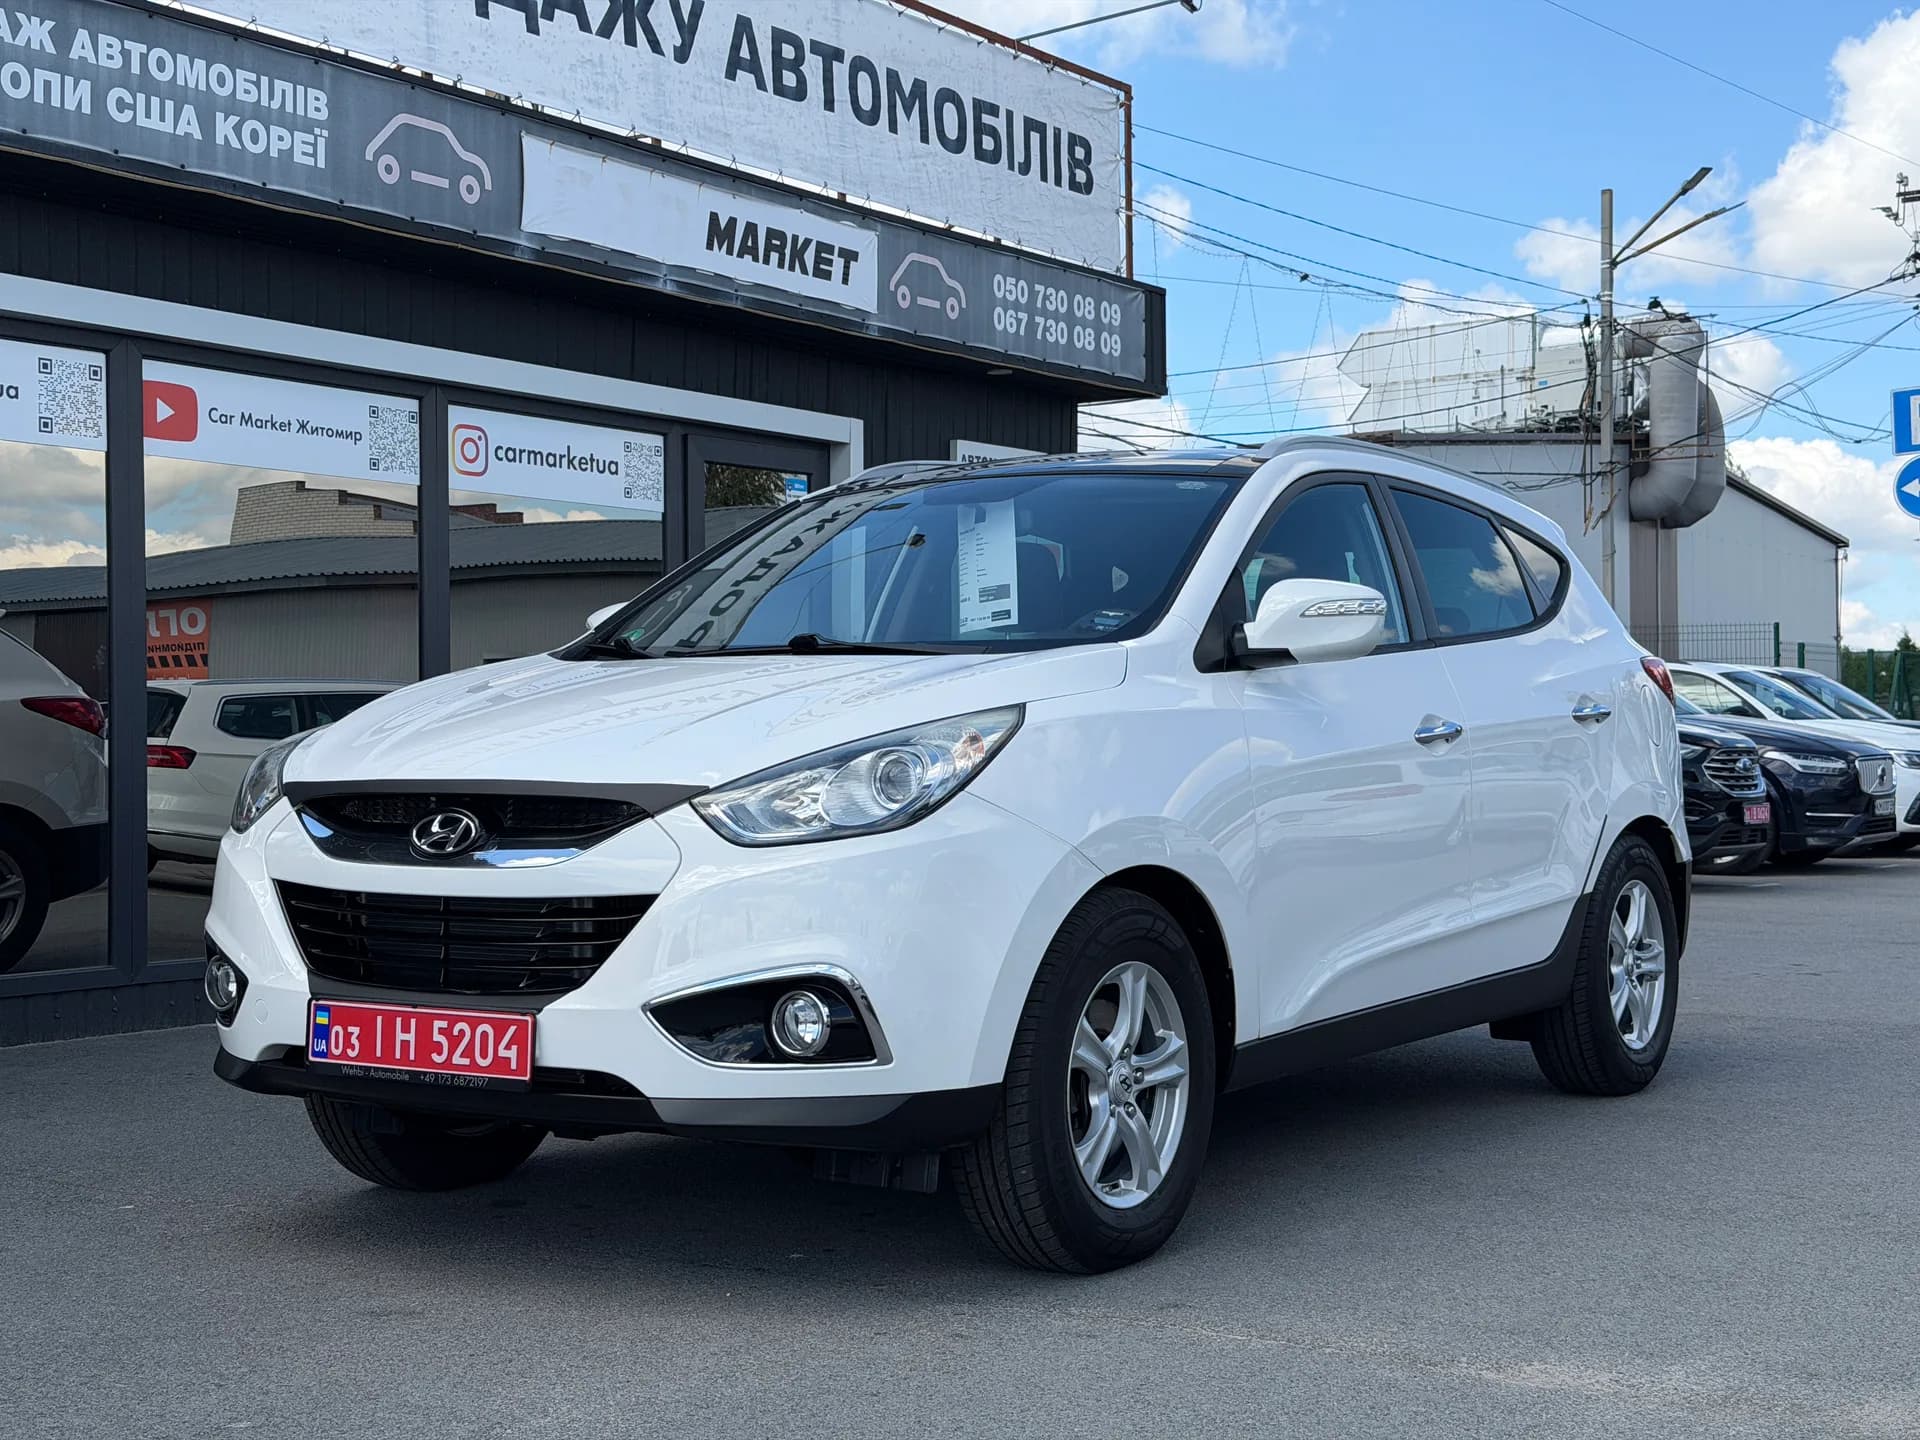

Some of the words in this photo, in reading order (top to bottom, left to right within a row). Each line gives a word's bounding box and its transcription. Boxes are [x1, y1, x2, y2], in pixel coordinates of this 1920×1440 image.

[69, 28, 329, 121] АВТОМОБІЛІВ
[106, 87, 203, 140] США
[215, 111, 329, 169] КОРЕЇ
[724, 13, 1095, 195] АВТОМОБІЛІВ
[705, 211, 860, 286] MARKET
[993, 274, 1029, 304] 050
[1034, 284, 1068, 313] 730
[1073, 294, 1096, 320] 08
[1100, 301, 1121, 326] 09
[993, 306, 1029, 336] 067
[1034, 316, 1068, 345] 730
[1073, 325, 1096, 351] 08
[1100, 331, 1121, 357] 09
[208, 407, 235, 425] Car
[239, 411, 292, 433] Market
[295, 418, 363, 445] Житомир
[494, 444, 619, 476] carmarketua
[314, 1038, 327, 1053] UA
[331, 1025, 360, 1058] 03
[431, 1020, 518, 1070] 5204
[420, 1073, 435, 1083] +49
[438, 1074, 451, 1086] 173
